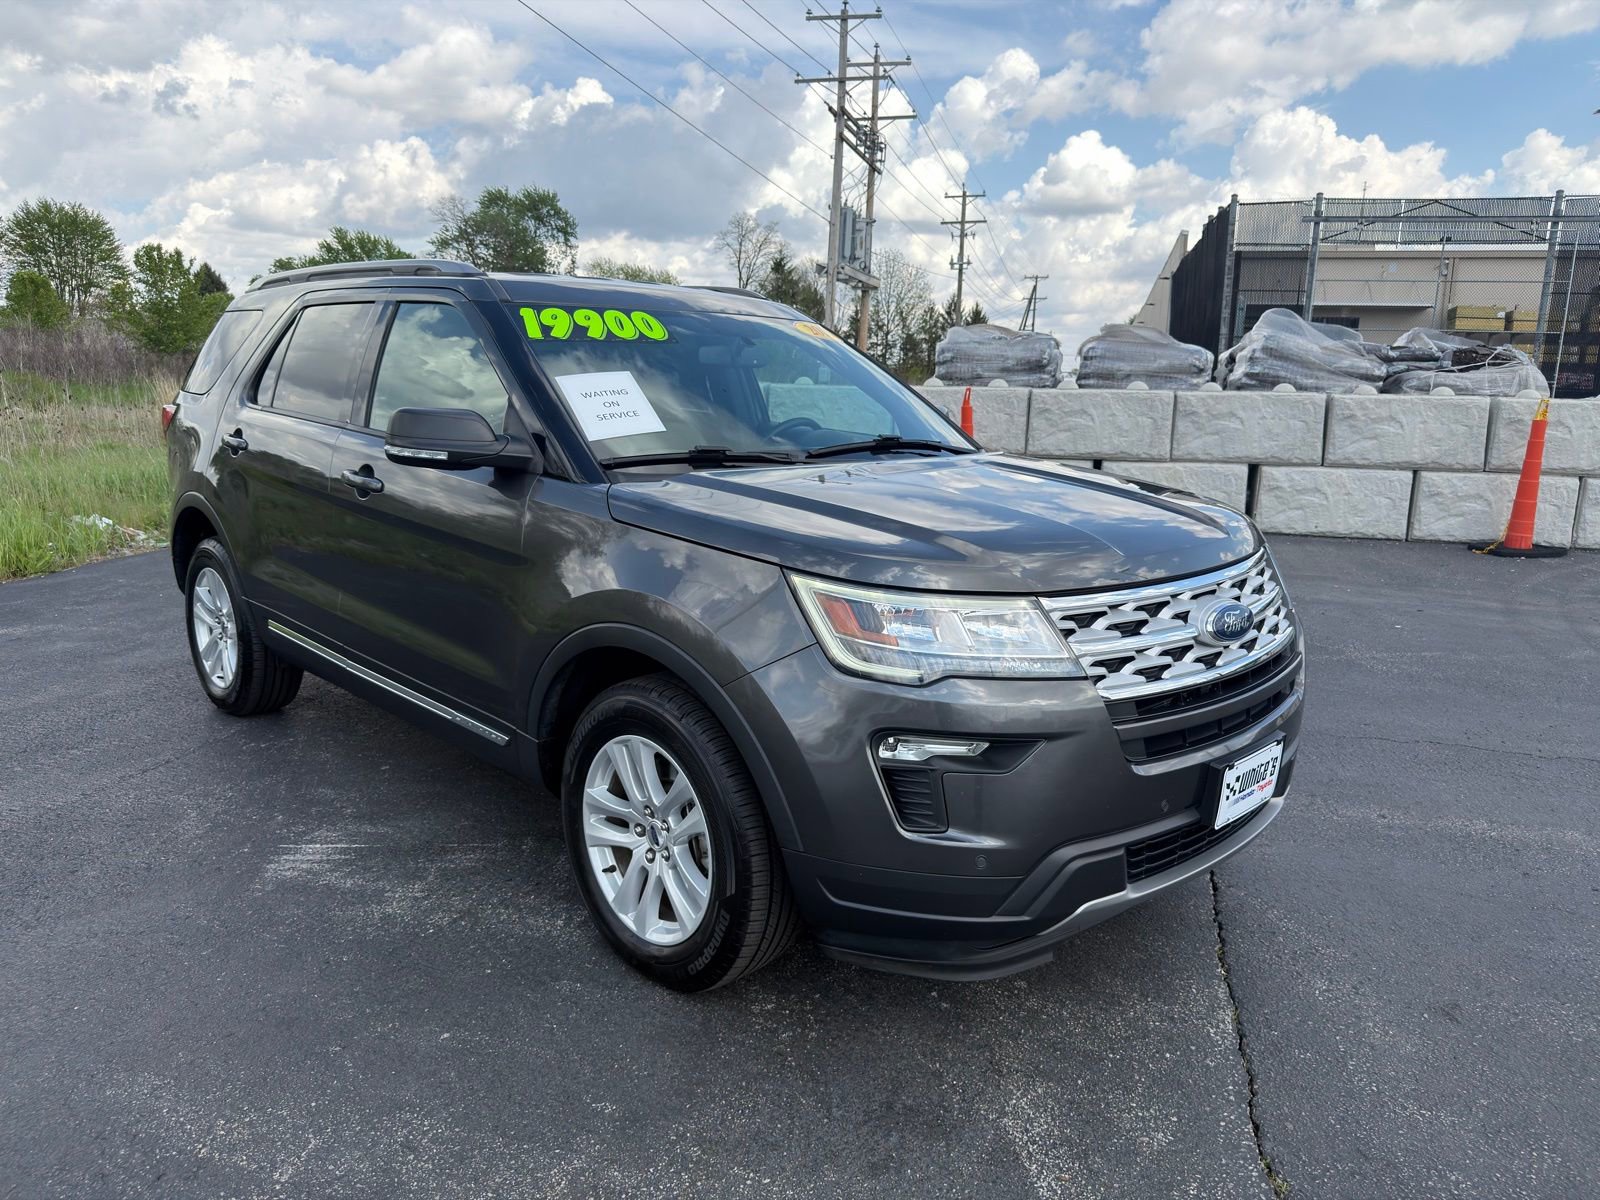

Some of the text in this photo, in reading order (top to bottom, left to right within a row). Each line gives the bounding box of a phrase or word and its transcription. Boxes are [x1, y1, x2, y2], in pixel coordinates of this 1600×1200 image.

[519, 307, 669, 341] 19900
[581, 388, 629, 399] WAITING
[596, 410, 640, 421] SERVICE
[1224, 610, 1250, 632] Ford
